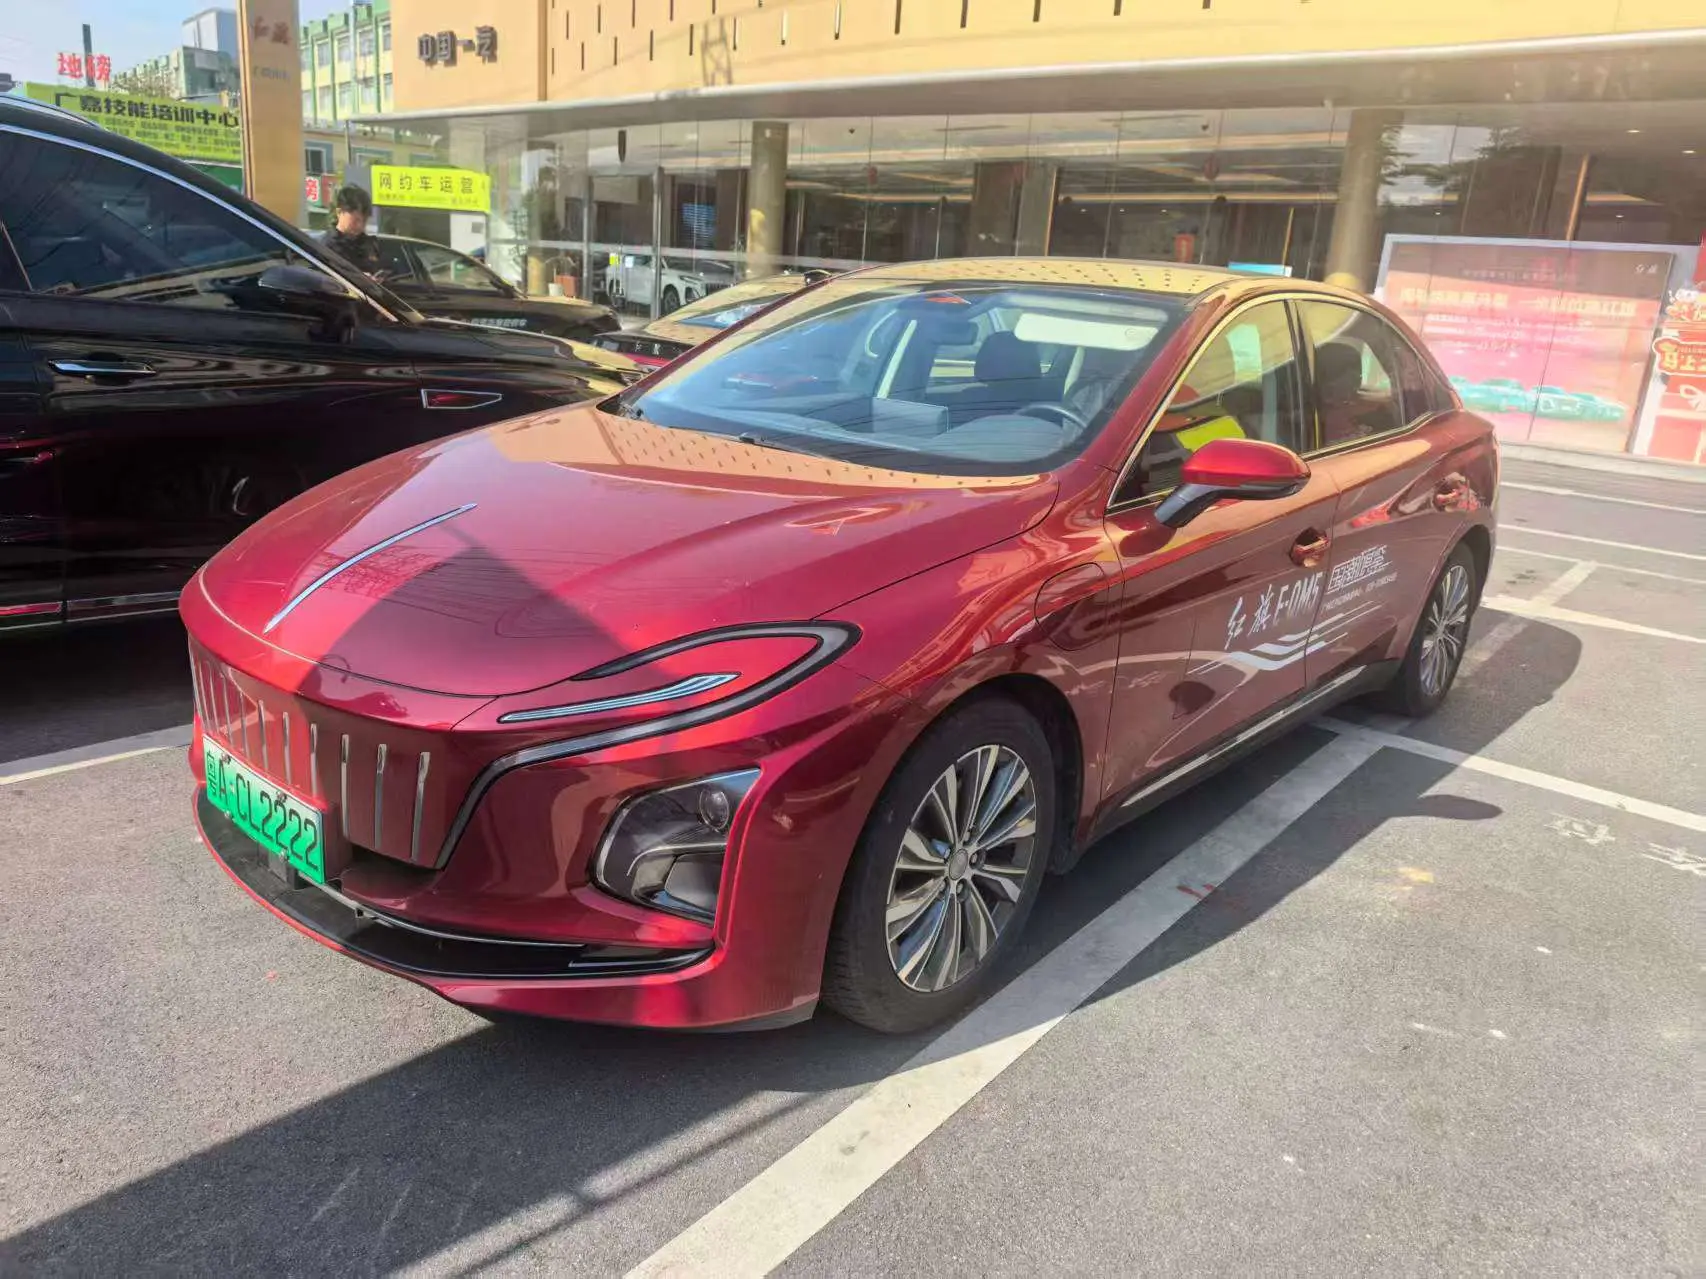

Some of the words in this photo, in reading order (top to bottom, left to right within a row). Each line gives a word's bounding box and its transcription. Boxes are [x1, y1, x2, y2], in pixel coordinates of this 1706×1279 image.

[417, 25, 497, 62] 中国一汽
[57, 52, 112, 81] 地磅
[379, 172, 486, 195] 网约车运营
